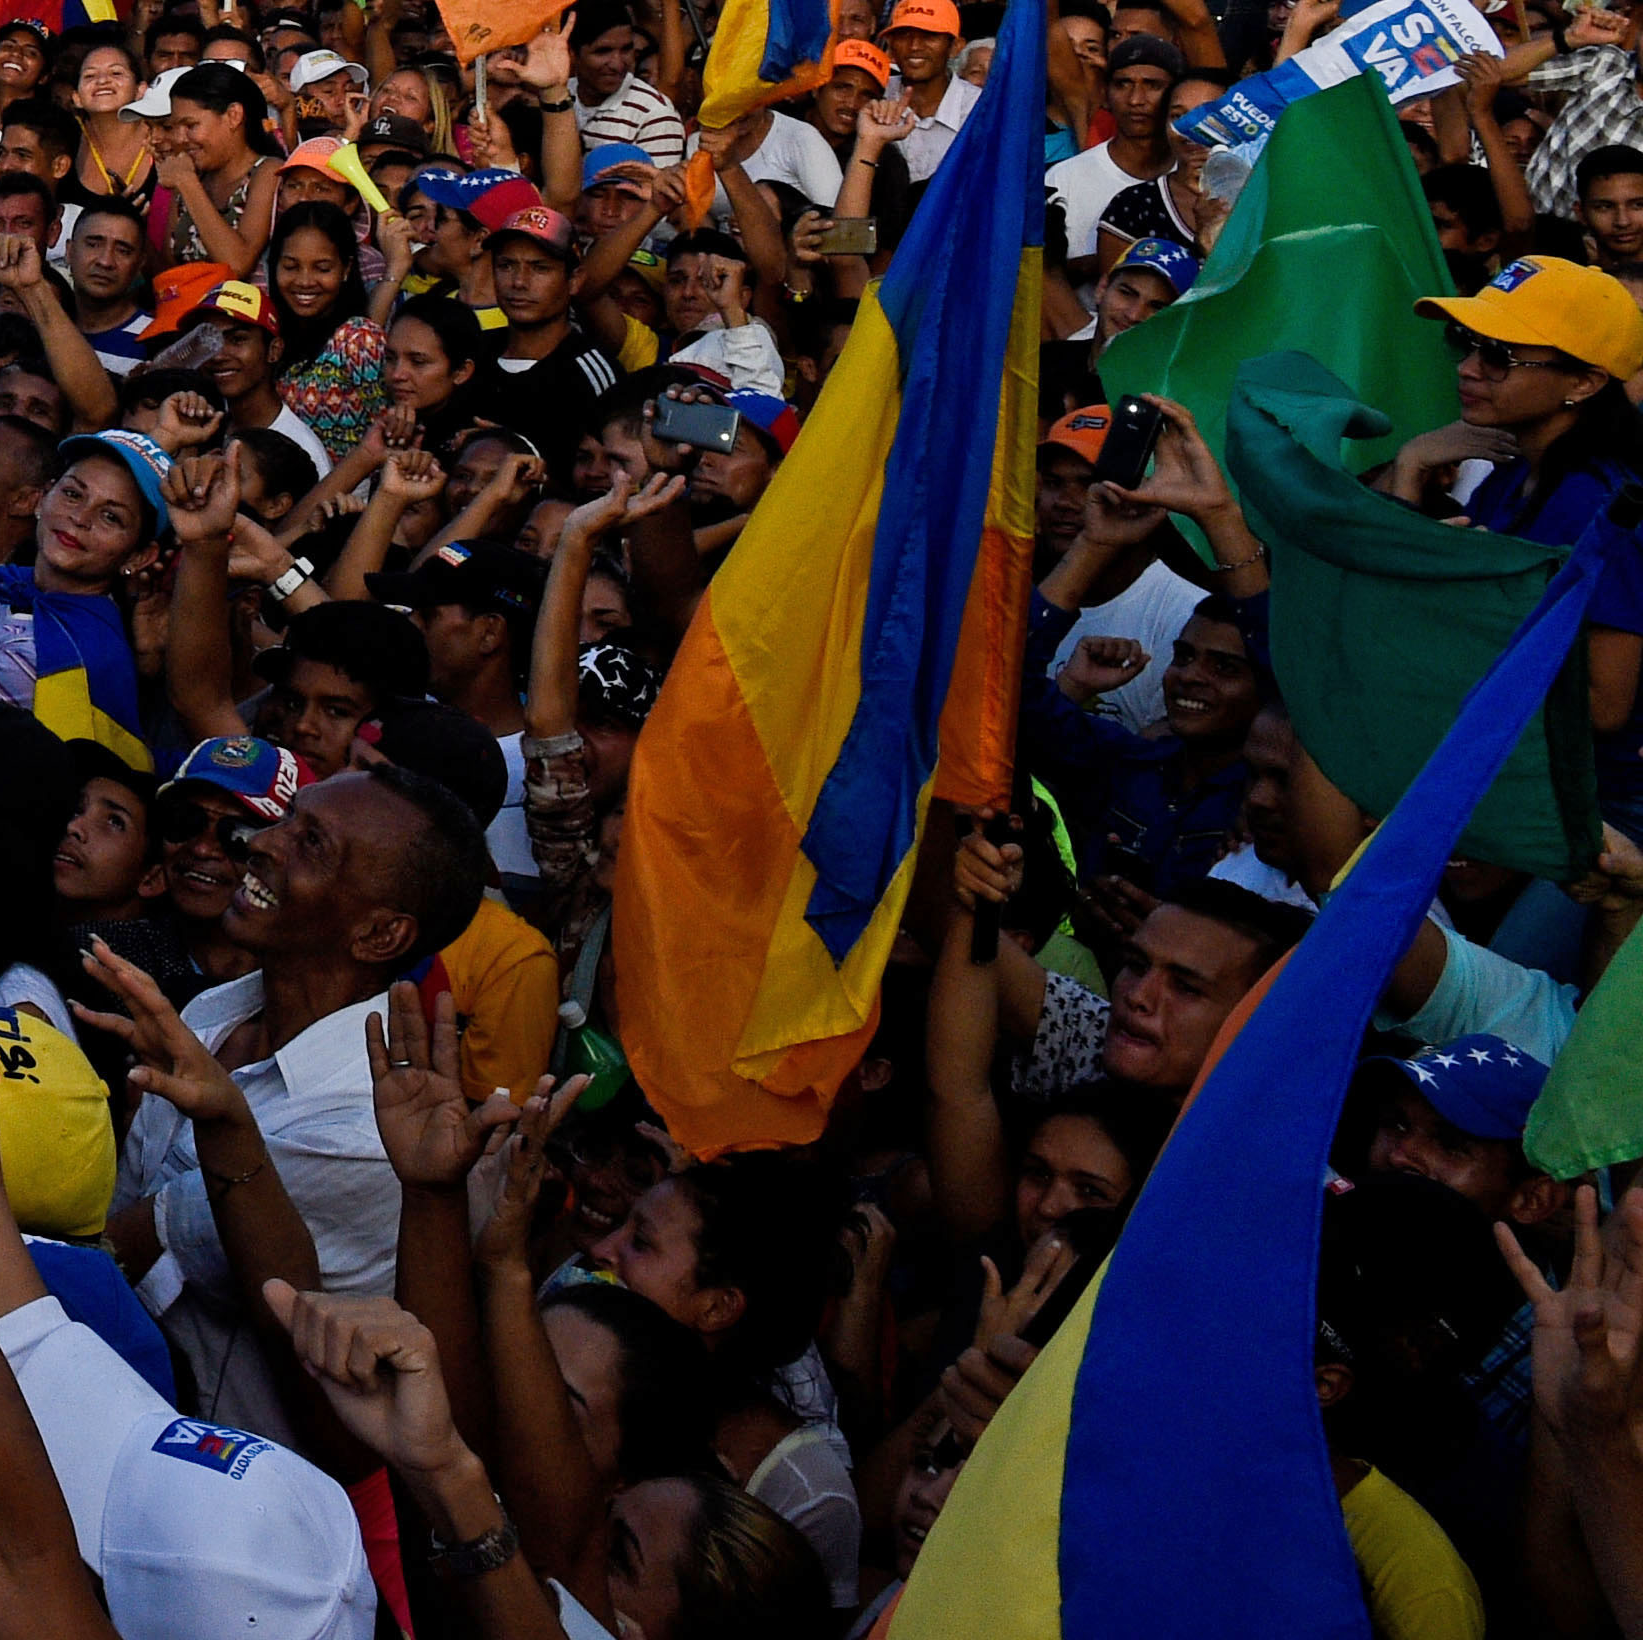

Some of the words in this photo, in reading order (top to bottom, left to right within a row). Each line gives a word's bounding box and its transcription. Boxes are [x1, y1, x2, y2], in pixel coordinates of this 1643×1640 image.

[1446, 13, 1483, 53] FALCÓ
[1362, 31, 1411, 87] VA
[164, 1420, 218, 1445] VA
